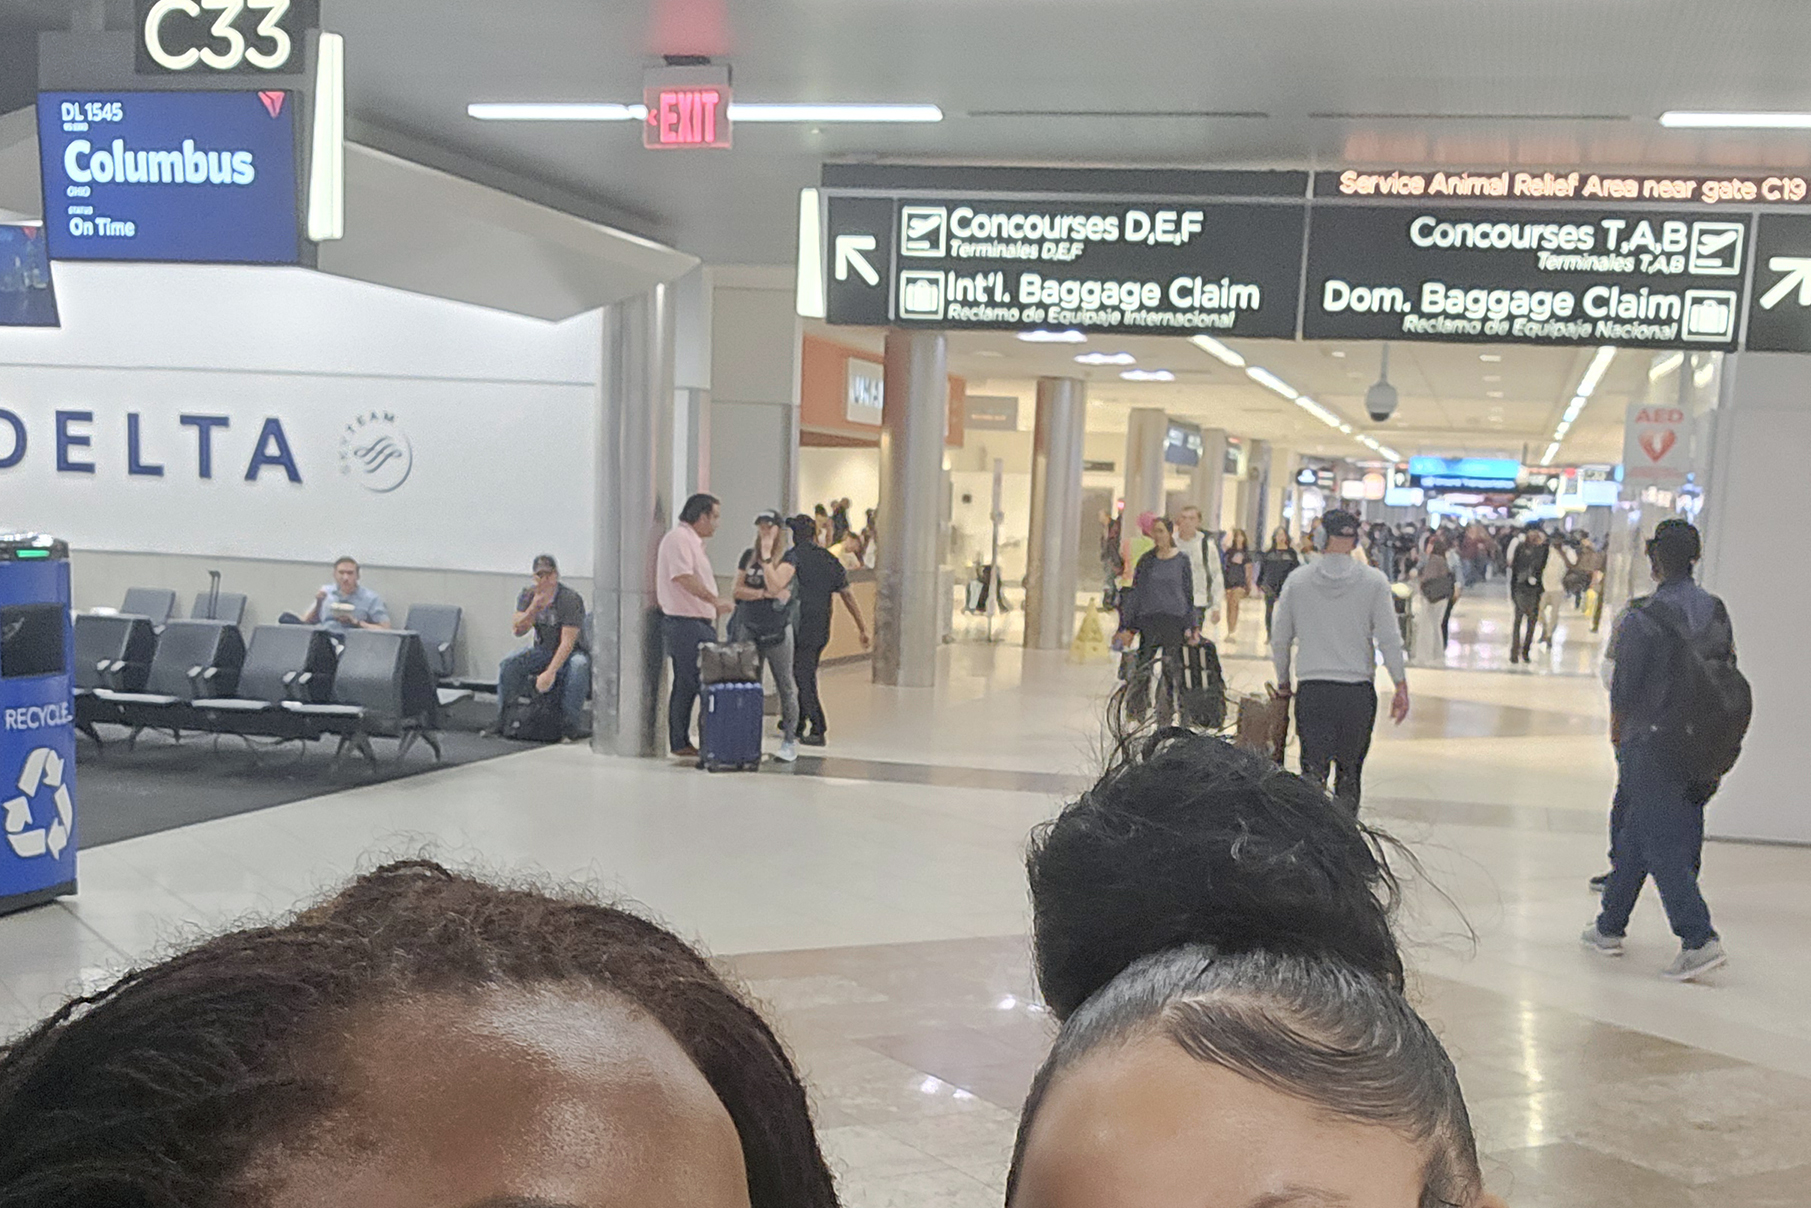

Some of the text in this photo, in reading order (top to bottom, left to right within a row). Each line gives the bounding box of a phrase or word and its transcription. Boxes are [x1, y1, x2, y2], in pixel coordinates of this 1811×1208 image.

[144, 0, 291, 70] C33
[61, 102, 123, 122] DL 1545
[660, 91, 719, 143] EXIT
[64, 138, 255, 184] Columbus
[1339, 169, 1807, 204] Service Animal Relief Area near gate C19
[69, 216, 135, 237] On Time
[950, 206, 1119, 241] Concourses
[1410, 216, 1595, 250] Concourses
[950, 238, 1039, 259] Terminales
[1536, 250, 1635, 272] Terminales
[947, 270, 1260, 311] Int'l. Baggage Claim
[1323, 279, 1681, 321] Dom. Baggage Claim
[947, 302, 1236, 329] Reclamo de Equipaje Internacional
[1402, 313, 1678, 341] Reclamo de Equipaje Nacional
[1634, 407, 1684, 423] AED
[5, 701, 74, 730] RECYCLE
